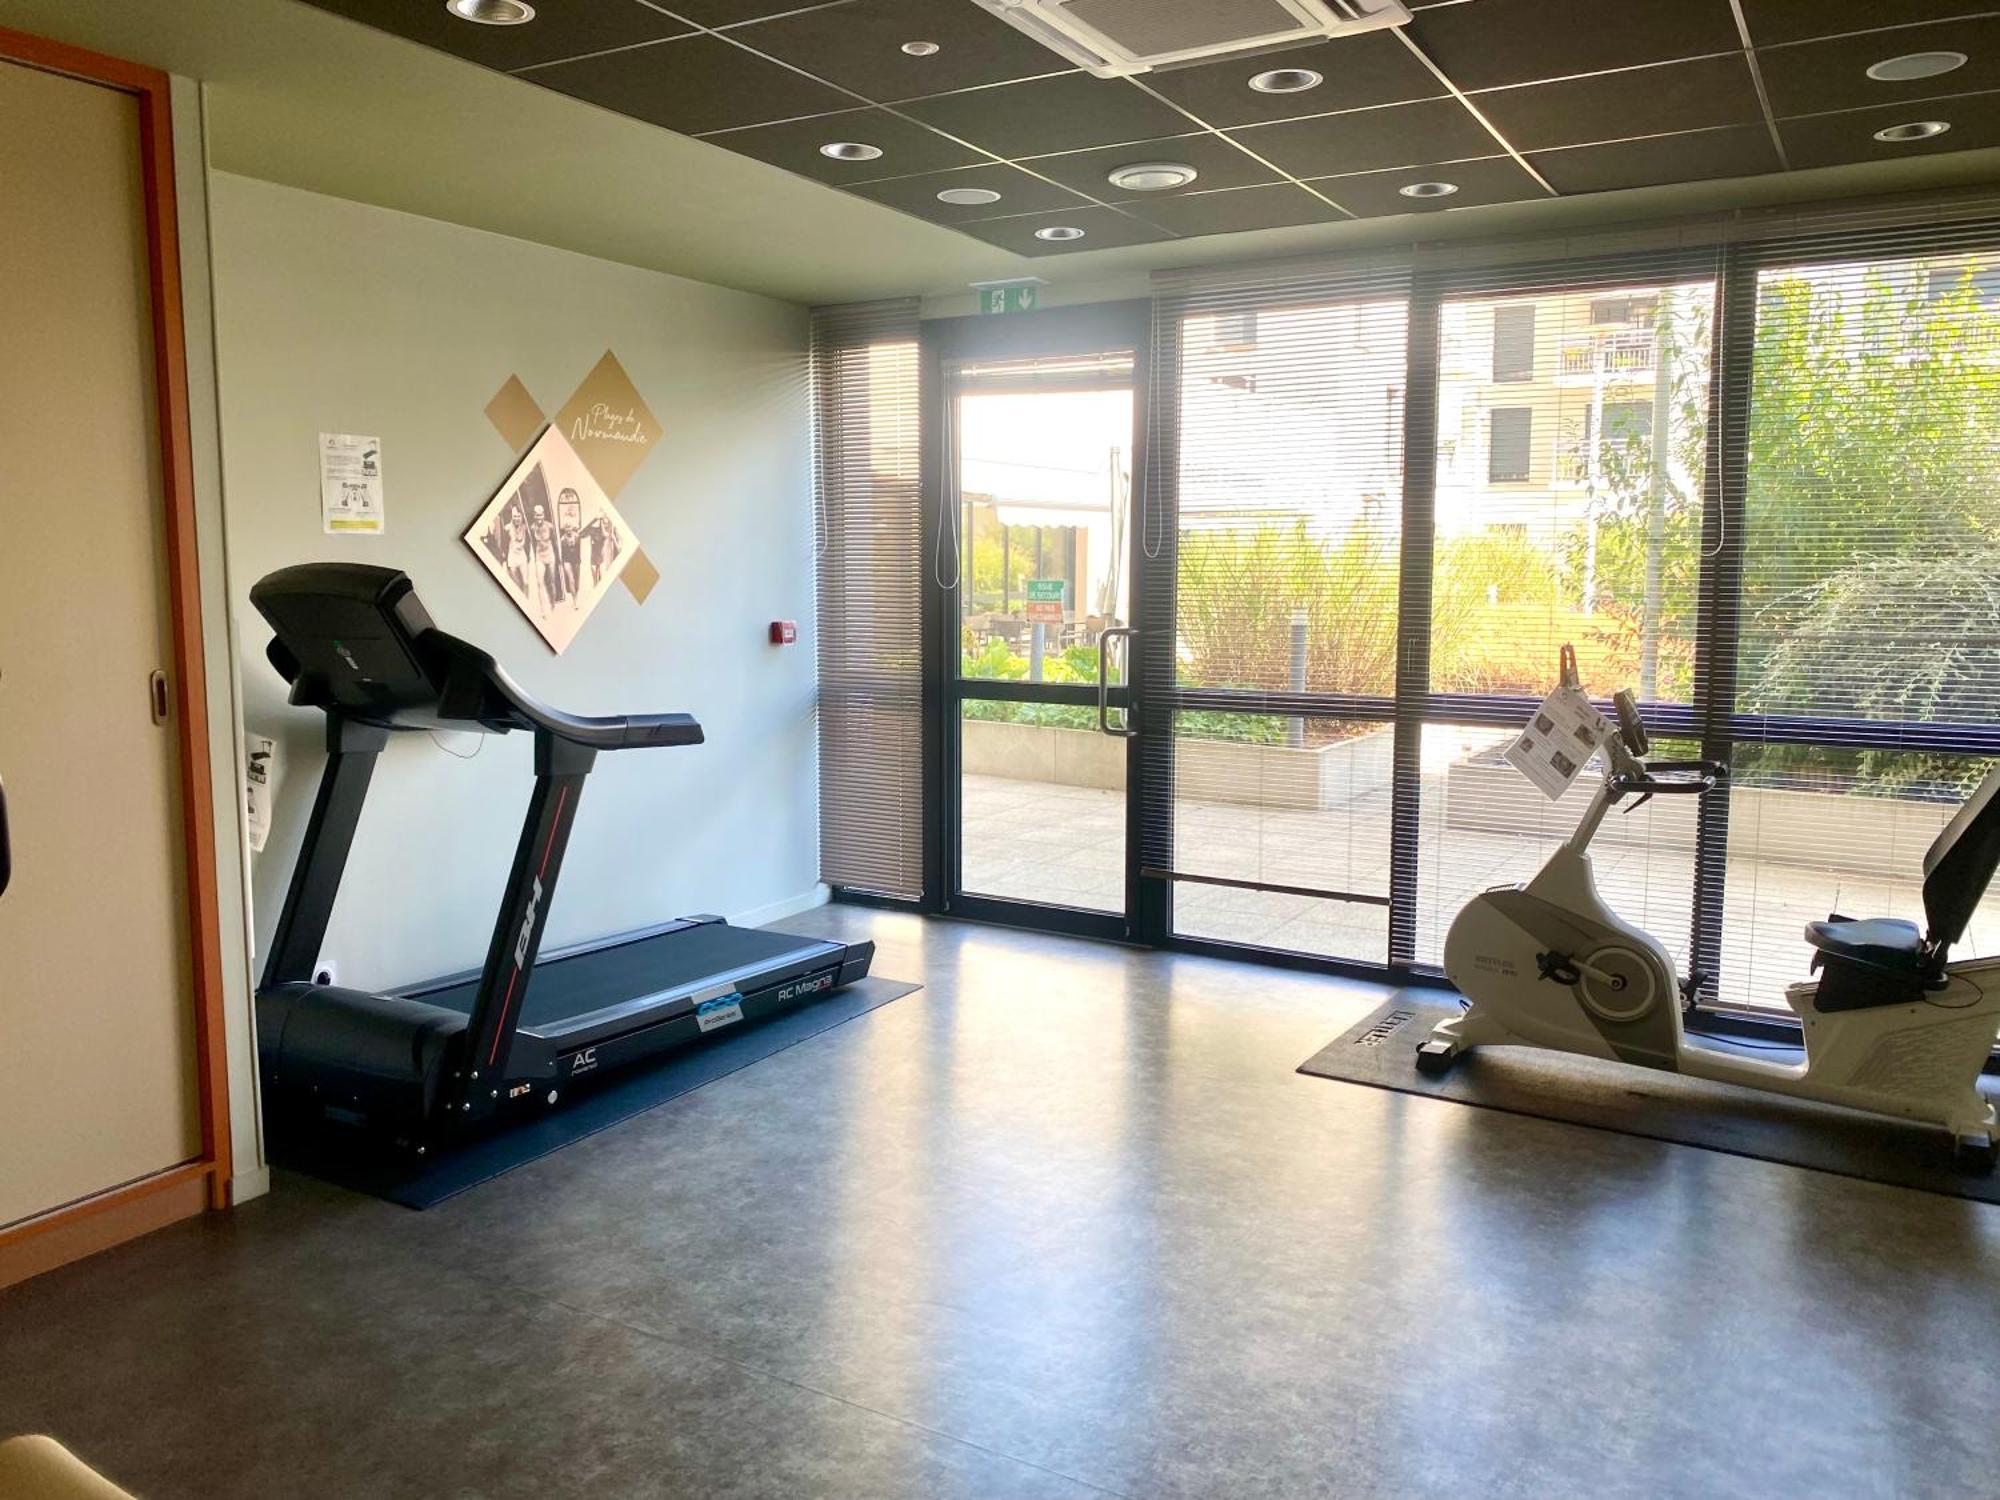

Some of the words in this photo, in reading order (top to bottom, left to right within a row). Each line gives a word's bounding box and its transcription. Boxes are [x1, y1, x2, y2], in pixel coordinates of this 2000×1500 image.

[570, 414, 648, 444] Normandie
[777, 987, 794, 1002] RC
[572, 1047, 596, 1069] AC
